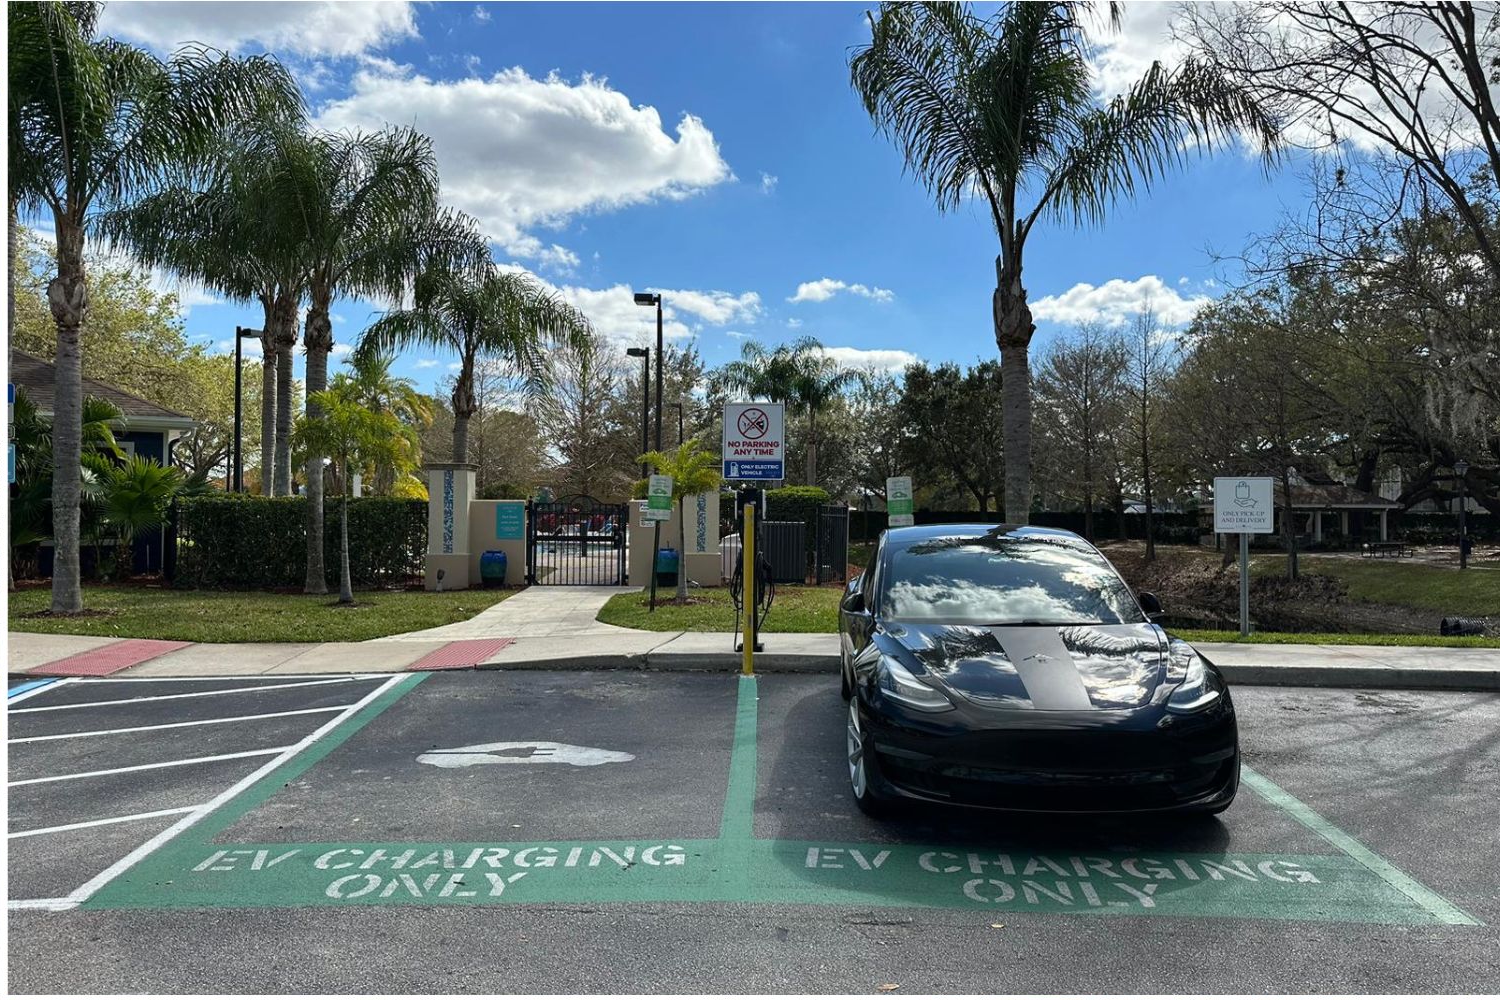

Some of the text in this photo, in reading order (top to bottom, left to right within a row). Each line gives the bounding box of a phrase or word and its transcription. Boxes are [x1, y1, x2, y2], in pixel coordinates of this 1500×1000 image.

[191, 845, 688, 872] EV CHARGING
[804, 846, 1322, 884] EV CHARGING
[325, 871, 529, 899] ONLY
[963, 877, 1161, 908] ONLY
